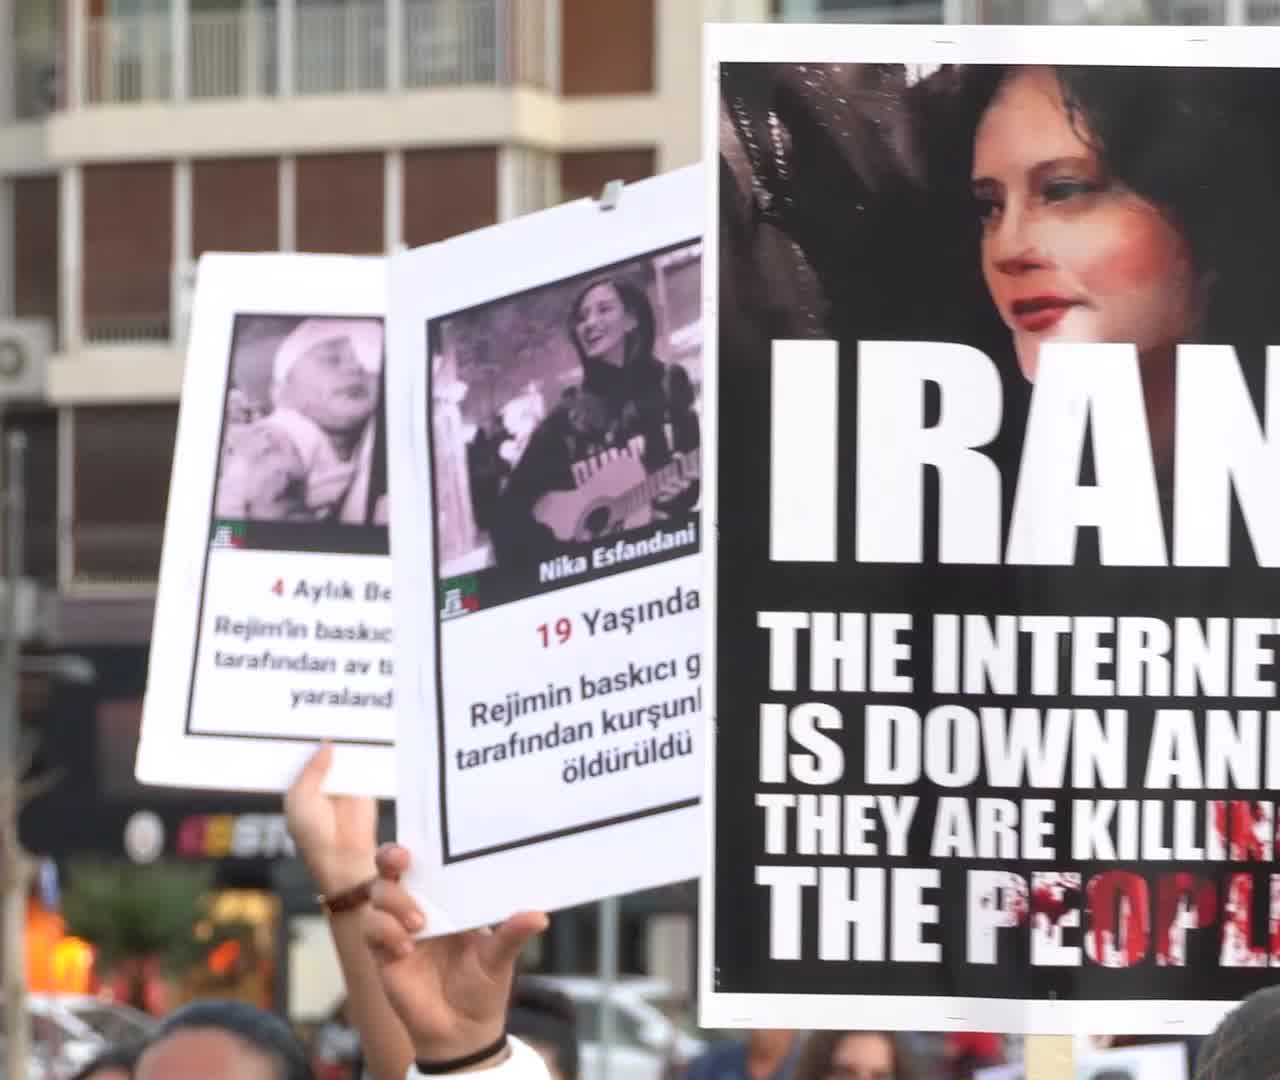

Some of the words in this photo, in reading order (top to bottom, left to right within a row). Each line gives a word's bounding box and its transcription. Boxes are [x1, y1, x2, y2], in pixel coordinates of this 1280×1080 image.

[538, 554, 588, 584] Nika
[592, 522, 697, 569] Esfandani
[271, 577, 285, 597] 4
[293, 578, 354, 605] Aylık
[536, 616, 573, 648] 19
[581, 586, 701, 637] Yaşında
[214, 651, 337, 673] tarafından
[344, 658, 371, 675] av
[758, 611, 914, 693] THE
[470, 684, 572, 729] Rejimin
[580, 650, 677, 701] baskıcı
[455, 721, 593, 772] tarafından
[562, 730, 693, 784] öldürüldü
[758, 703, 844, 785] IS
[864, 705, 1128, 788] DOWN
[755, 793, 919, 856] THEY
[931, 796, 1056, 858] ARE
[755, 866, 942, 963] THE
